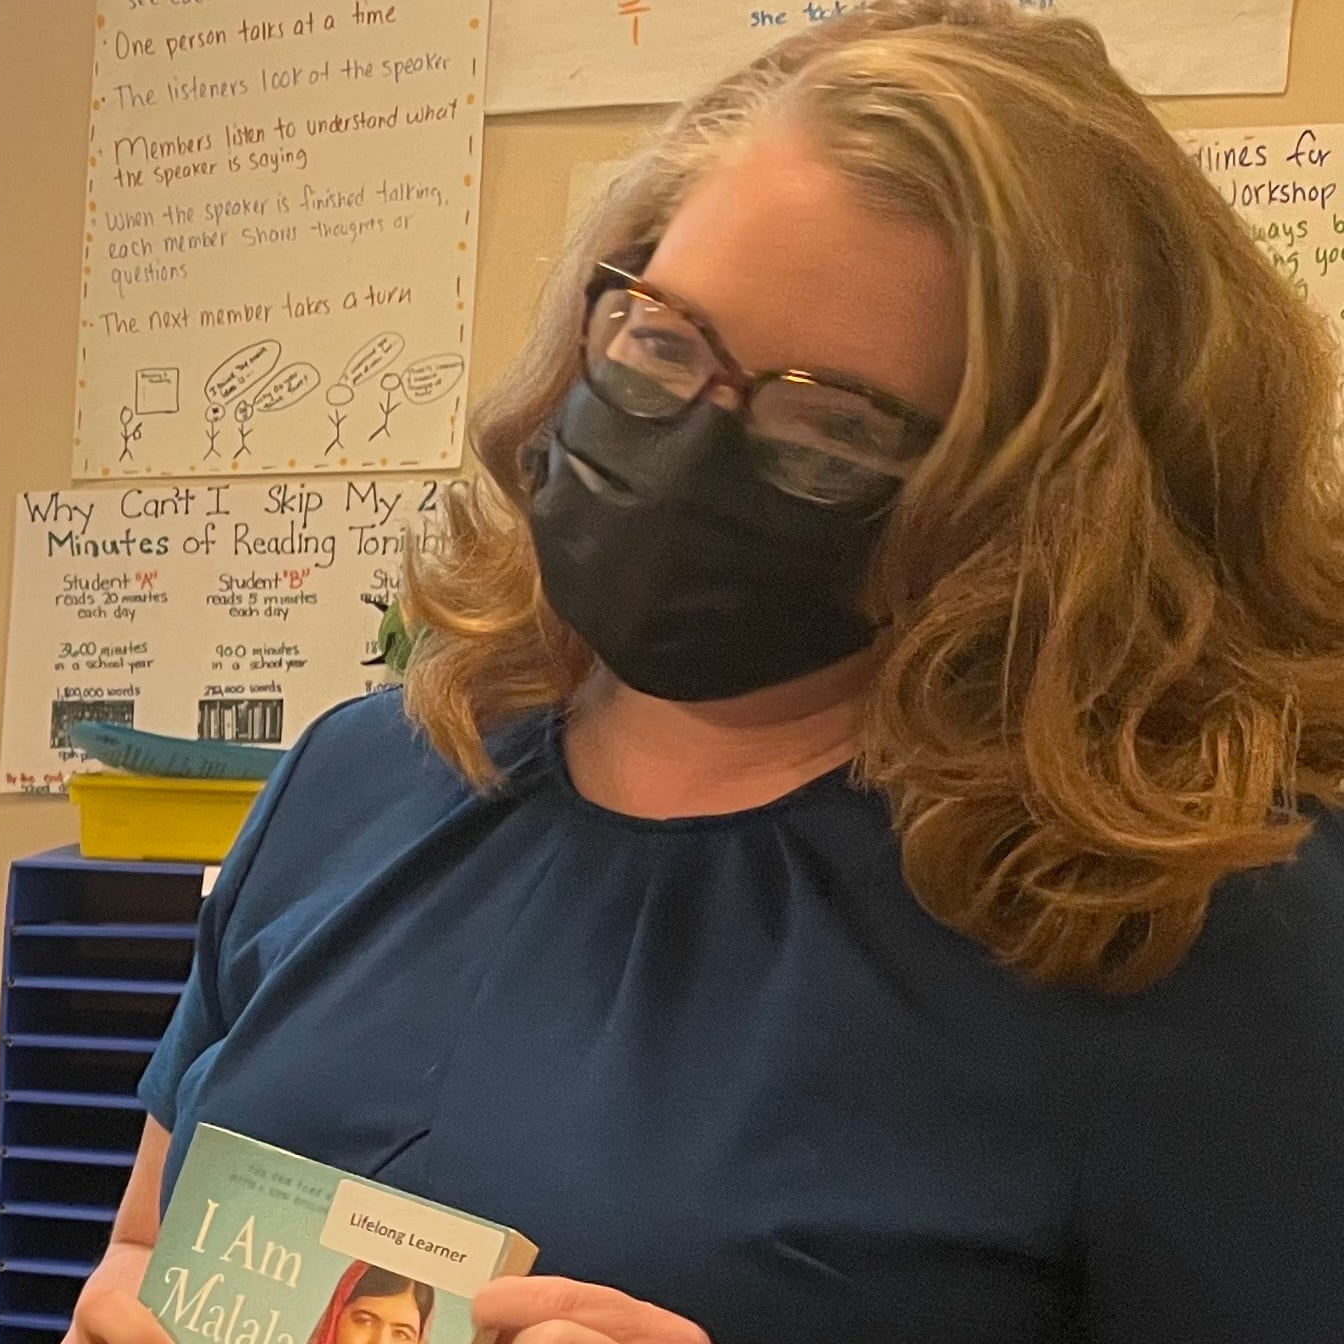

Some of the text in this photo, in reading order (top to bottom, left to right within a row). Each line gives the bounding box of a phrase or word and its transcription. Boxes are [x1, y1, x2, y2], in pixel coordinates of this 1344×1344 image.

[115, 1, 397, 59] One person talks at a time
[114, 52, 452, 110] The listeners look at the speaker
[114, 98, 460, 164] Members listen to understand what
[113, 148, 308, 192] the speaker is saying
[107, 207, 155, 232] When
[162, 201, 195, 225] the
[205, 196, 269, 227] speaker
[277, 193, 290, 214] is
[299, 184, 365, 214] finished
[108, 229, 227, 260] each member
[111, 263, 189, 299] questions
[99, 285, 413, 336] The next member takes a turn
[23, 480, 403, 535] Why Can't I Skip My
[47, 519, 337, 569] Minutes of Reading
[62, 571, 132, 593] Student
[218, 570, 282, 593] Student
[55, 590, 96, 607] reads
[77, 605, 137, 623] each day
[206, 591, 244, 606] reads
[262, 591, 319, 606] minutes
[228, 605, 291, 622] each day
[86, 656, 125, 670] school
[127, 659, 154, 675] year
[249, 655, 283, 670] school
[285, 658, 308, 673] year
[252, 641, 300, 657] minutes
[106, 684, 141, 698] words
[190, 1198, 305, 1289] I Am
[349, 1211, 469, 1266] Lifelong Learner
